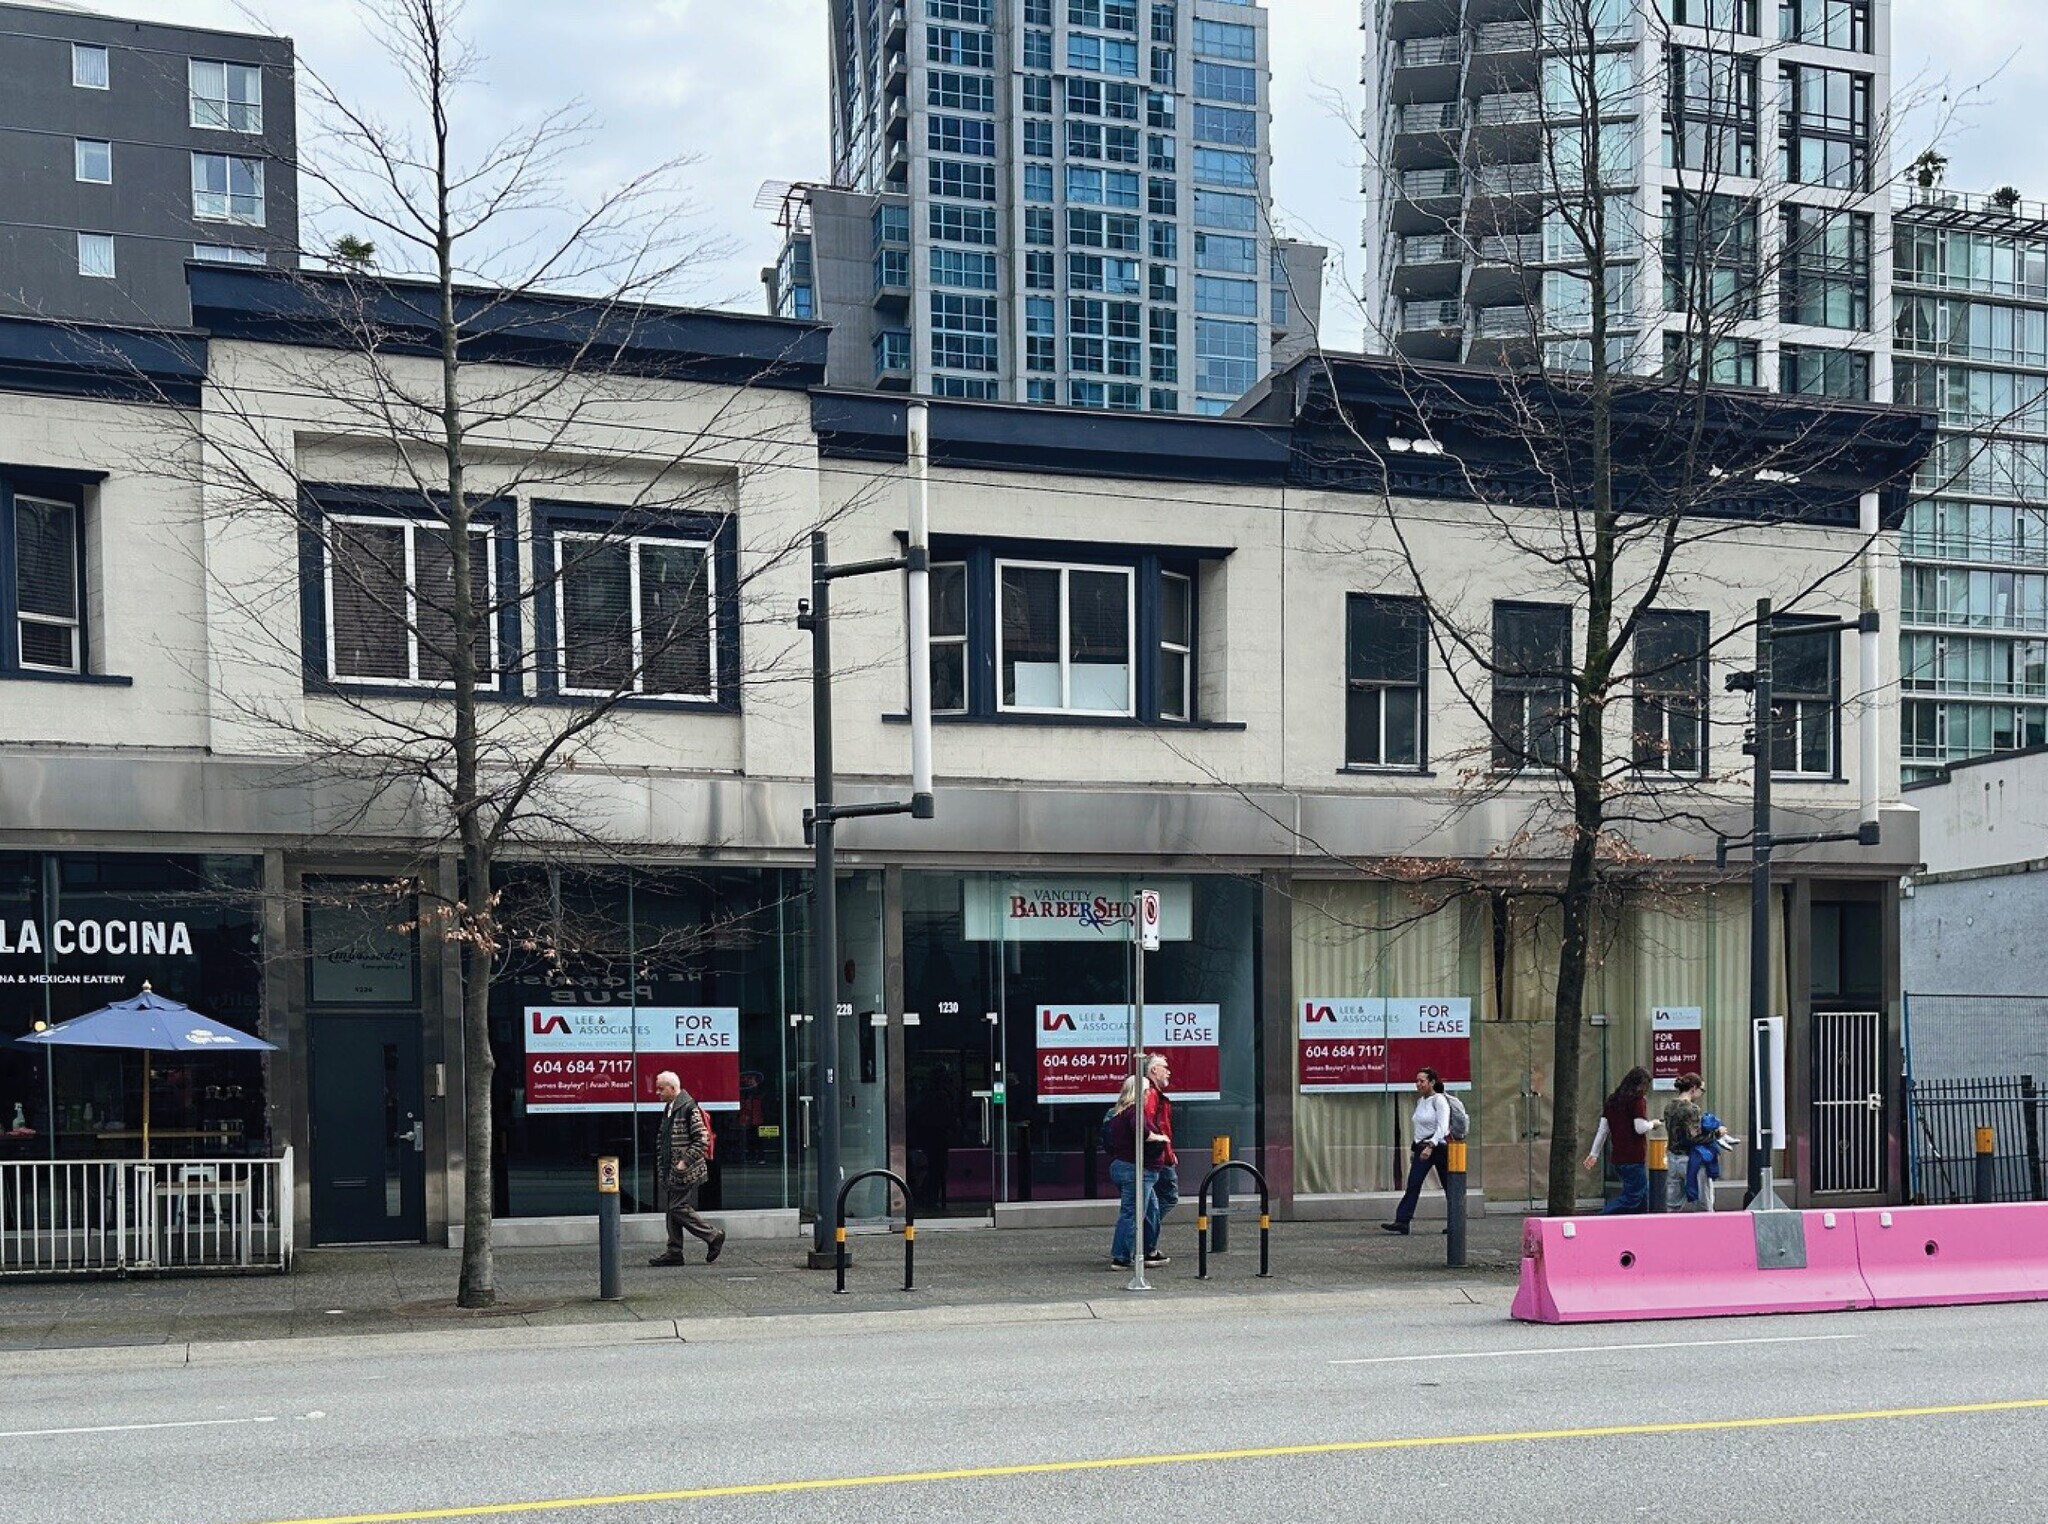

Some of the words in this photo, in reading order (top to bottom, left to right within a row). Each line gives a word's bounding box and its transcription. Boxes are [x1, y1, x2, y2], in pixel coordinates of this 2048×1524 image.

[1033, 889, 1092, 900] VANCITY
[1010, 896, 1137, 918] BARBERSHO
[0, 919, 42, 954] LA
[53, 919, 193, 955] COCINA
[18, 975, 26, 984] &
[30, 975, 81, 984] MEXICAN
[83, 975, 126, 984] EATERY
[836, 1003, 853, 1016] 228
[938, 1001, 959, 1014] 1230
[1339, 1006, 1356, 1014] LEE
[1358, 1006, 1364, 1014] &
[1419, 1004, 1450, 1018] FOR
[575, 1015, 595, 1025] LEE
[598, 1015, 606, 1025] &
[675, 1015, 713, 1030] FOR
[1079, 1013, 1096, 1022] LEE
[1098, 1013, 1105, 1021] &
[1165, 1012, 1197, 1025] FOR
[579, 1025, 651, 1035] ASSOCIATES
[1082, 1022, 1132, 1032] ASSOCIAT
[1419, 1020, 1464, 1033] LEASE
[675, 1033, 731, 1047] LEASE
[1165, 1028, 1212, 1042] LEASE
[1655, 1033, 1673, 1042] FOR
[1306, 1046, 1328, 1058] 604
[1331, 1046, 1355, 1058] 684
[1358, 1045, 1385, 1057] 7117
[1655, 1042, 1681, 1051] LEASE
[1043, 1054, 1068, 1068] 604
[1071, 1054, 1096, 1068] 684
[1099, 1053, 1128, 1067] 7117
[1655, 1055, 1668, 1063] 604
[1669, 1055, 1681, 1063] 684
[533, 1060, 562, 1074] 604
[566, 1060, 595, 1074] 684
[599, 1059, 633, 1073] 7117
